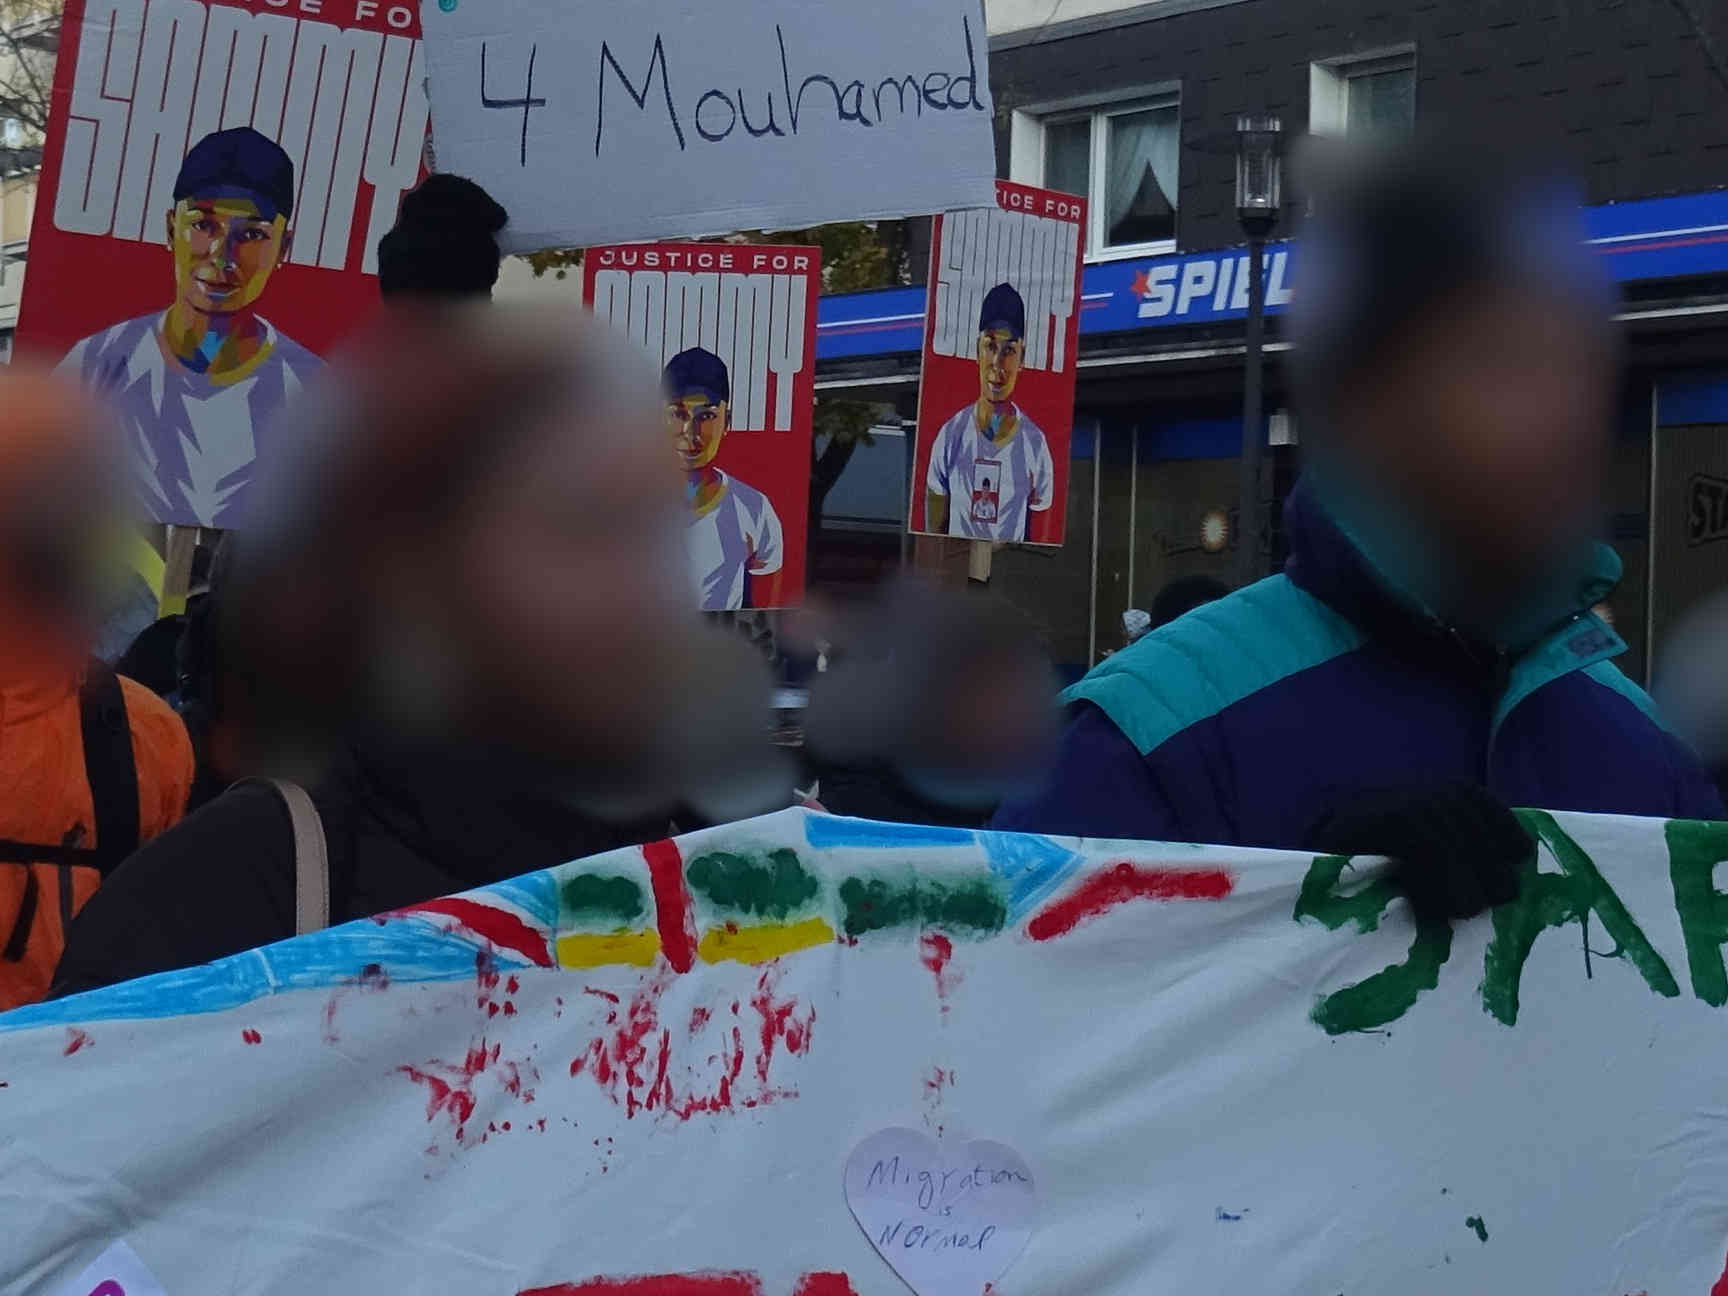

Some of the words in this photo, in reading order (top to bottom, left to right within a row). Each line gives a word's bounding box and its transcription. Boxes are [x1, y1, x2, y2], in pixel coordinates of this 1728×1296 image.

[355, 0, 412, 29] FO
[478, 40, 546, 167] 4
[595, 16, 989, 157] Mouhamed
[1045, 196, 1081, 218] FOR
[599, 250, 734, 268] JUSTICE
[753, 254, 809, 270] FOR
[867, 1156, 1028, 1210] Migration
